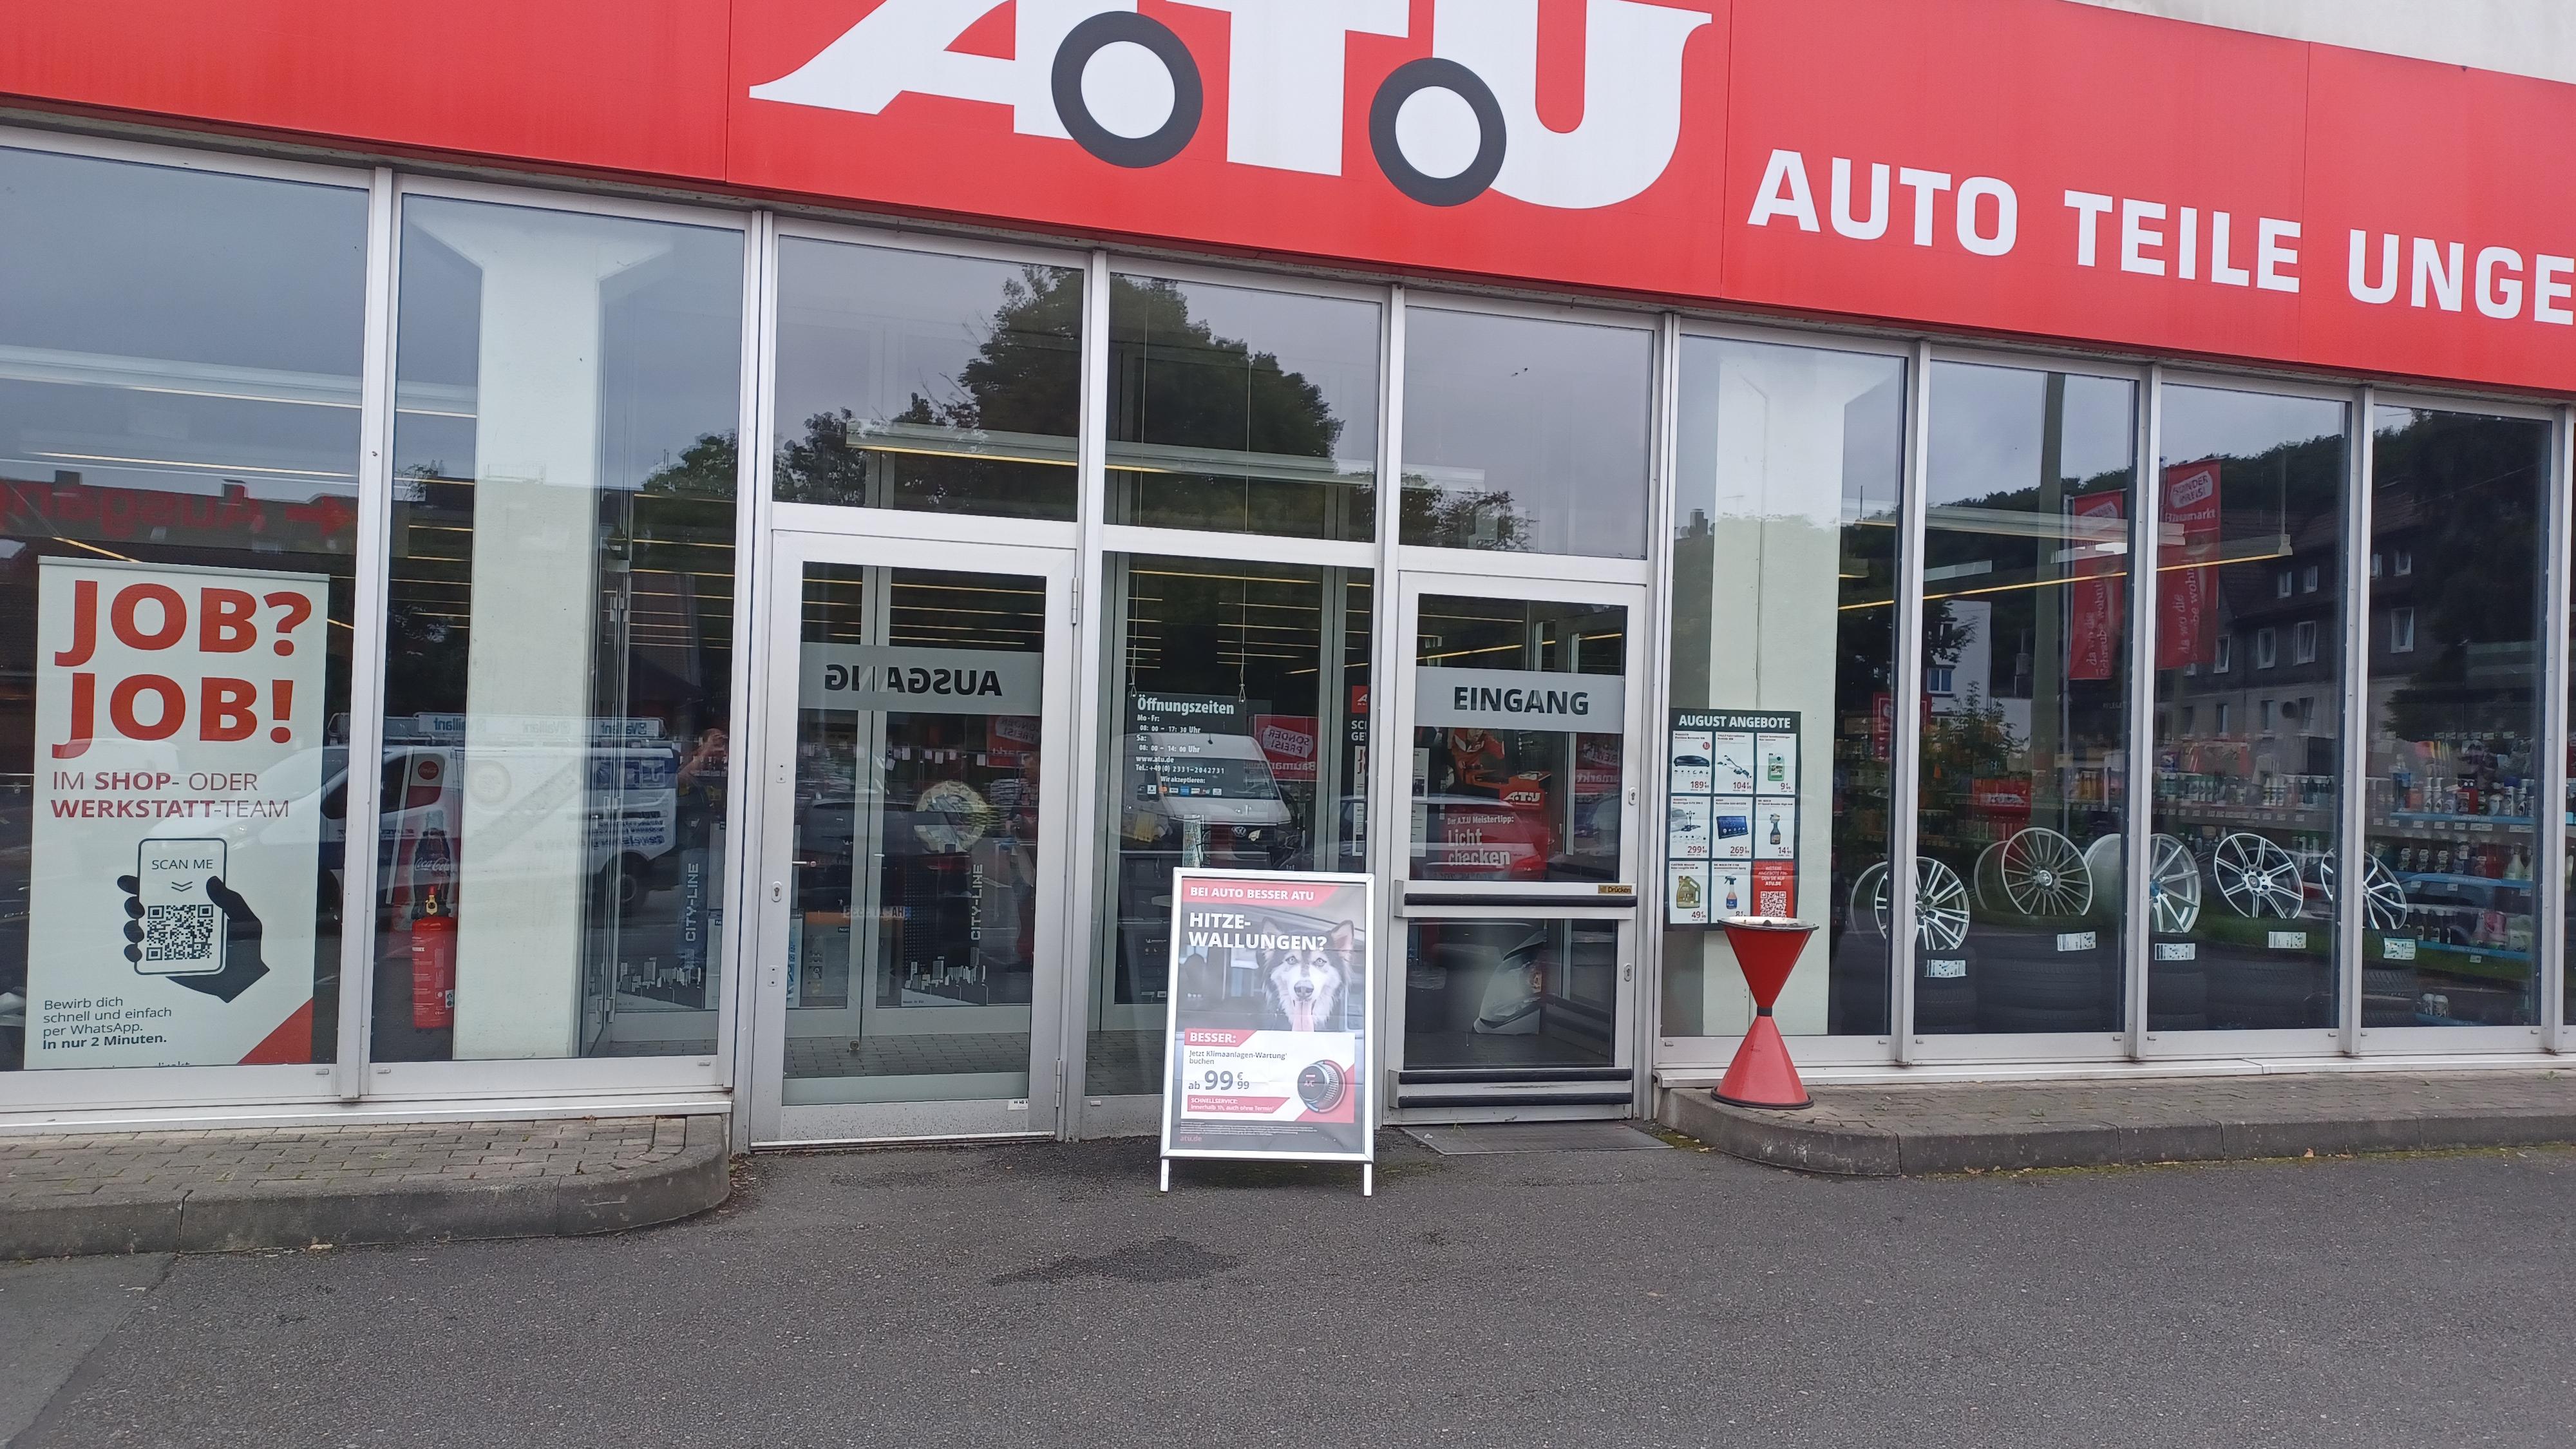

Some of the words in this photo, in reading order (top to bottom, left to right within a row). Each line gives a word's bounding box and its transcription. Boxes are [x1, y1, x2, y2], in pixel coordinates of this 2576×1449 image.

[1747, 149, 2018, 256] AUTO
[2065, 190, 2301, 293] TEILE
[2348, 229, 2574, 325] UNGE
[55, 580, 312, 667] JOB?
[1137, 694, 1234, 715] Öffnungszeiten
[1454, 687, 1589, 715] EINGANG
[52, 672, 294, 759] JOB!
[1678, 715, 1727, 727] AUGUST
[1728, 716, 1791, 728] ANGEBOTE
[53, 772, 84, 790] IM
[94, 772, 180, 790] SHOP-
[189, 773, 258, 791] ODER
[50, 799, 289, 819] WERKSTATT-TEAM
[1472, 815, 1514, 825] Meistertipp:
[1448, 828, 1482, 847] Licht
[151, 859, 189, 870] SCAN
[193, 859, 214, 869] ME
[1448, 848, 1511, 867] checken
[685, 863, 699, 942] CITY-LINE
[971, 863, 983, 940] CITY-LINE
[1190, 887, 1208, 897] BEI
[1211, 887, 1244, 898] AUTO
[1247, 889, 1288, 900] BESSER
[1291, 891, 1314, 900] ATU
[1189, 912, 1252, 929] HITZE-
[1188, 931, 1327, 951] WALLUNGEN?
[44, 998, 91, 1010] Bewirb
[96, 996, 123, 1007] dich
[43, 1010, 90, 1023] schnell
[95, 1009, 120, 1021] und
[124, 1007, 172, 1019] einfach
[43, 1027, 66, 1039] per
[70, 1022, 143, 1036] WhatsApp.
[1189, 1032, 1236, 1043] BESSER:
[43, 1039, 57, 1050] In
[61, 1038, 87, 1048] nur
[91, 1037, 100, 1046] 2
[104, 1034, 167, 1046] Minuten.
[1188, 1081, 1200, 1090] ab
[1204, 1070, 1233, 1090] 99
[1237, 1081, 1249, 1090] 99
